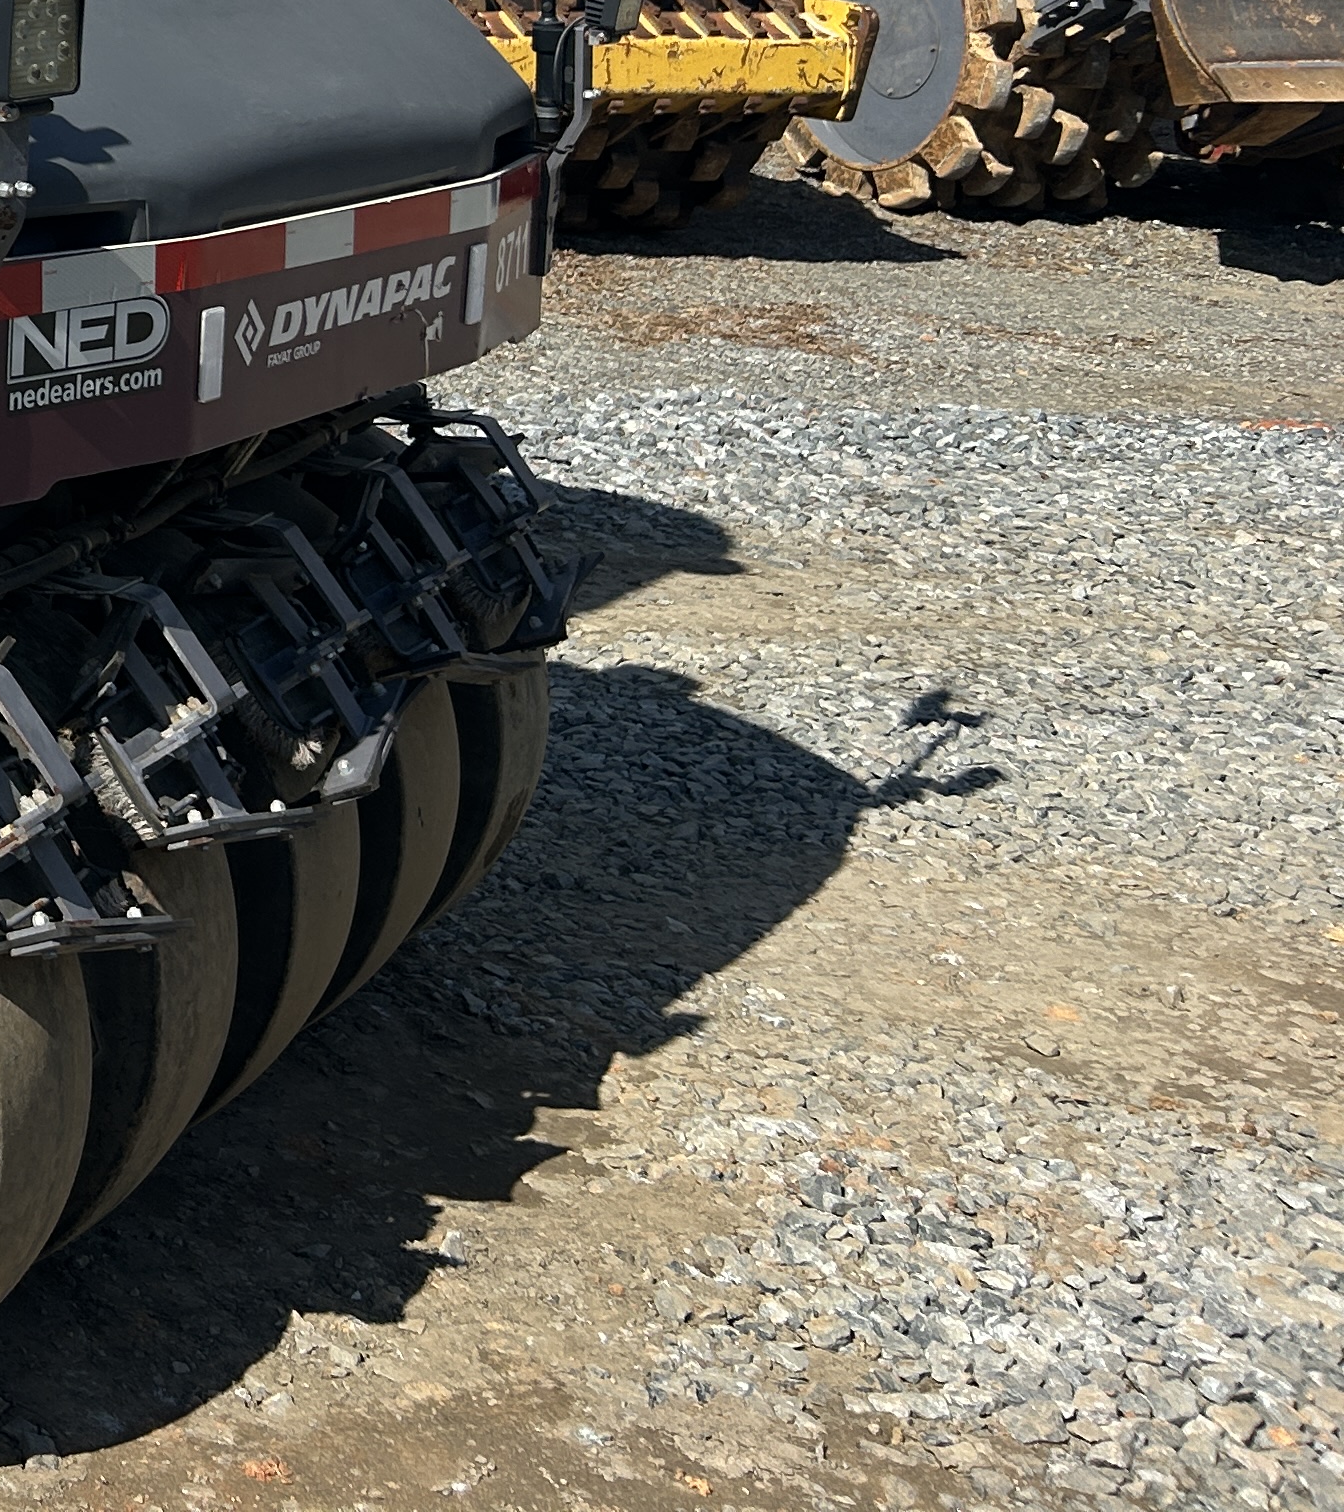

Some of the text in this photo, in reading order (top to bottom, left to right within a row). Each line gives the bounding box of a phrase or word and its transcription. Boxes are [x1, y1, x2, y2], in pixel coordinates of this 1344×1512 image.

[494, 220, 531, 294] 8711
[10, 295, 169, 378] NED
[268, 255, 457, 348] DYNAPAC
[8, 367, 162, 411] nedealers.com
[266, 340, 321, 368] FAYAT GROUP
